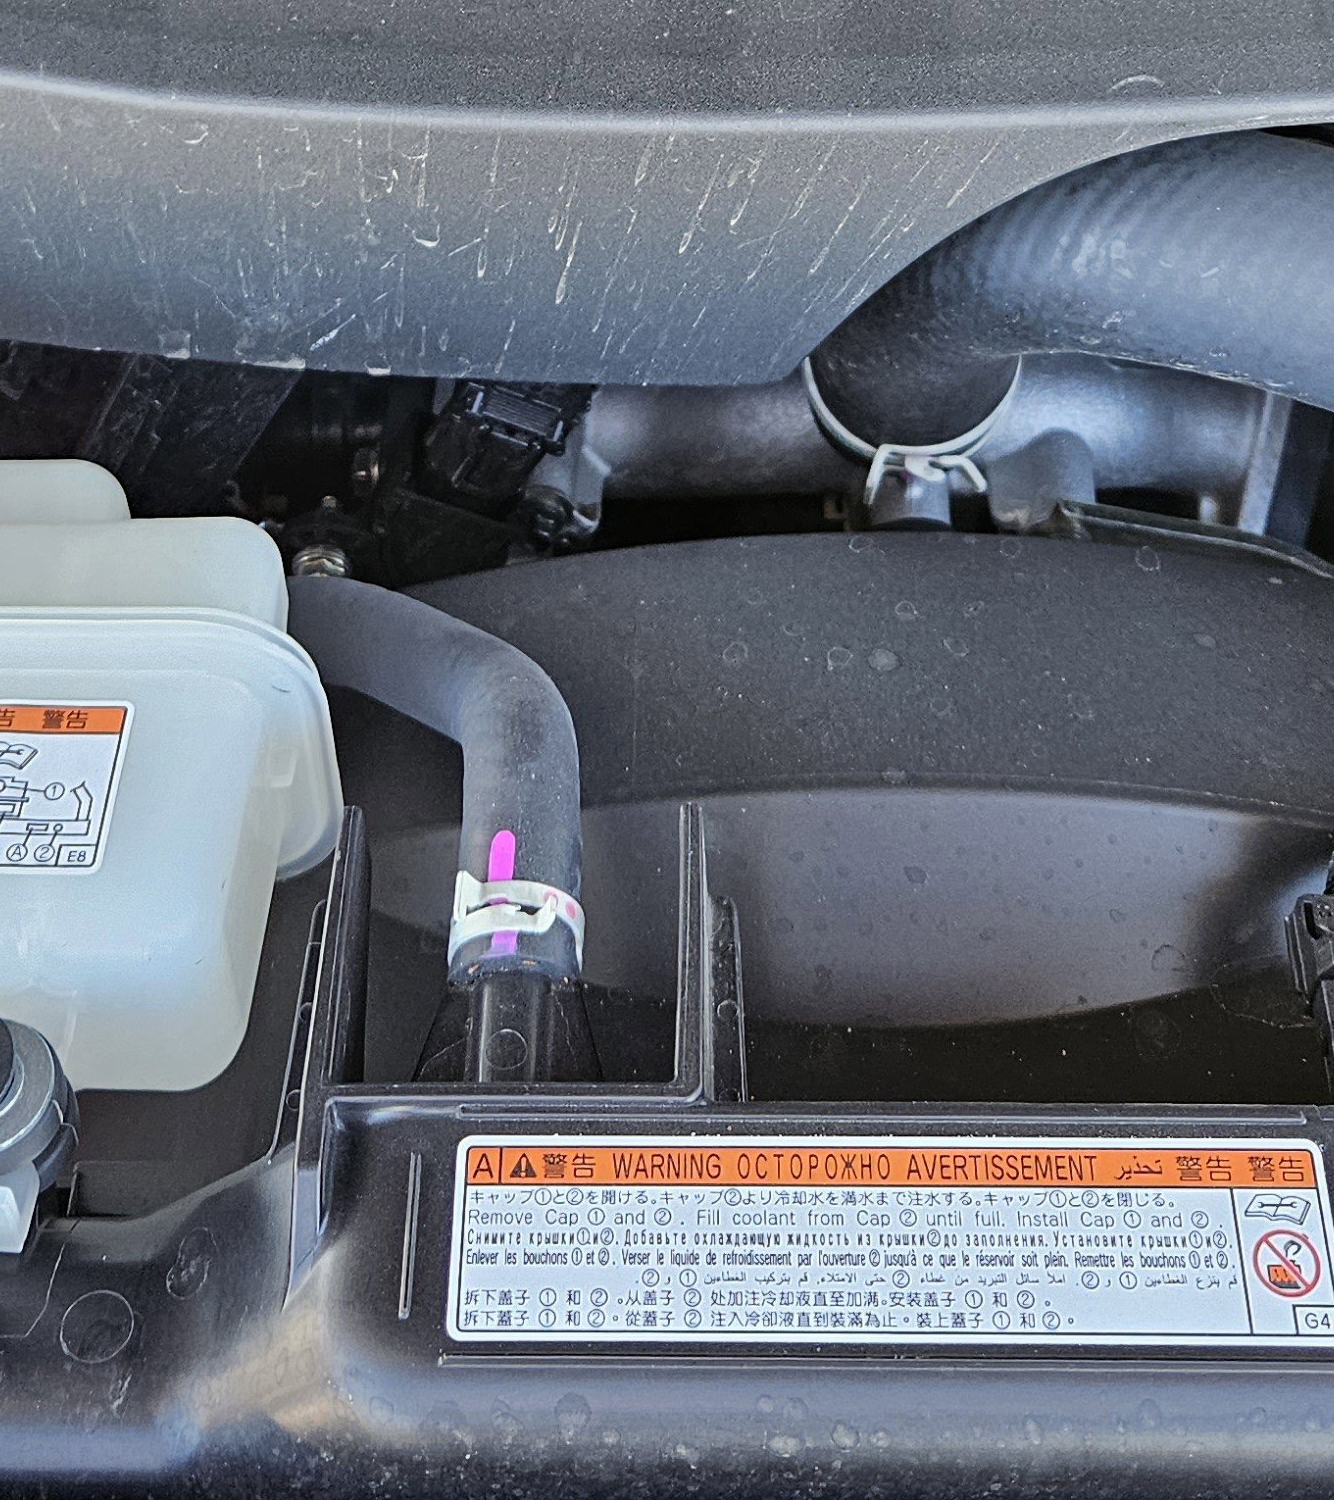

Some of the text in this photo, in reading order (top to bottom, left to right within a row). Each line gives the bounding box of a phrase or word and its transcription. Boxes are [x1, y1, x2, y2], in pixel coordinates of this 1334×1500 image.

[41, 710, 89, 729] 警告
[67, 850, 87, 863] E8
[472, 1152, 1305, 1182] A 警告 WARNING ОСТОРОЖНО AVERTISSEMENT تحذير 警告 警告
[468, 1209, 533, 1225] Remove
[545, 1209, 579, 1227] Cap
[614, 1209, 646, 1225] and
[697, 1209, 720, 1226] Fill
[732, 1209, 796, 1226] coolant
[808, 1209, 845, 1226] from
[857, 1209, 891, 1228] Cap
[926, 1210, 962, 1227] until
[975, 1210, 1006, 1227] full.
[1018, 1211, 1068, 1228] Install
[1080, 1211, 1115, 1230] Cap
[1151, 1212, 1183, 1228] and
[857, 1232, 871, 1246] из
[1053, 1230, 1133, 1248] Установите
[467, 1248, 499, 1265] Enlever
[504, 1248, 517, 1265] les
[523, 1248, 567, 1266] bouchons
[586, 1249, 596, 1265] et
[622, 1248, 651, 1266] Verser
[656, 1249, 665, 1266] le
[670, 1249, 700, 1268] liquide
[706, 1249, 717, 1266] de
[723, 1249, 792, 1266] refroidissement
[798, 1252, 813, 1268] par
[818, 1249, 866, 1267] l'ouverture
[884, 1250, 917, 1269] jusqu'à
[923, 1253, 934, 1267] ce
[939, 1253, 957, 1269] que
[961, 1250, 970, 1267] le
[976, 1250, 1015, 1267] réservoir
[1021, 1250, 1039, 1267] soit
[1044, 1250, 1069, 1269] plein.
[1075, 1251, 1116, 1268] Remettre
[1121, 1251, 1134, 1268] les
[1140, 1251, 1186, 1269] bouchons
[1204, 1251, 1214, 1268] et
[567, 1290, 581, 1306] 和
[992, 1291, 1008, 1308] 和
[566, 1310, 581, 1327] 和
[1020, 1312, 1036, 1328] 和
[1305, 1312, 1331, 1329] G4
